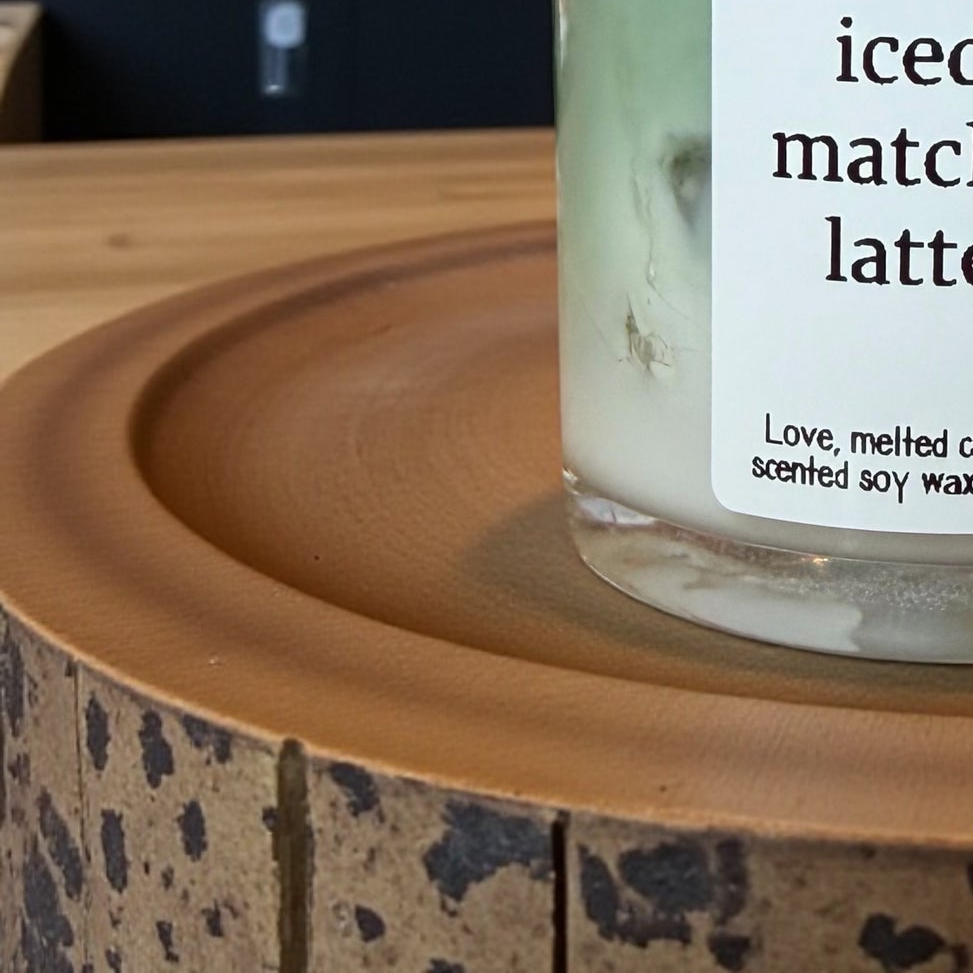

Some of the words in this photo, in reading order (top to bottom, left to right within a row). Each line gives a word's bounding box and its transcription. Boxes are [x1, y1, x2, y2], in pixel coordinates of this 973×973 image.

[764, 412, 841, 457] Love,
[849, 424, 949, 459] melted
[750, 454, 850, 491] scented
[857, 469, 911, 505] soy
